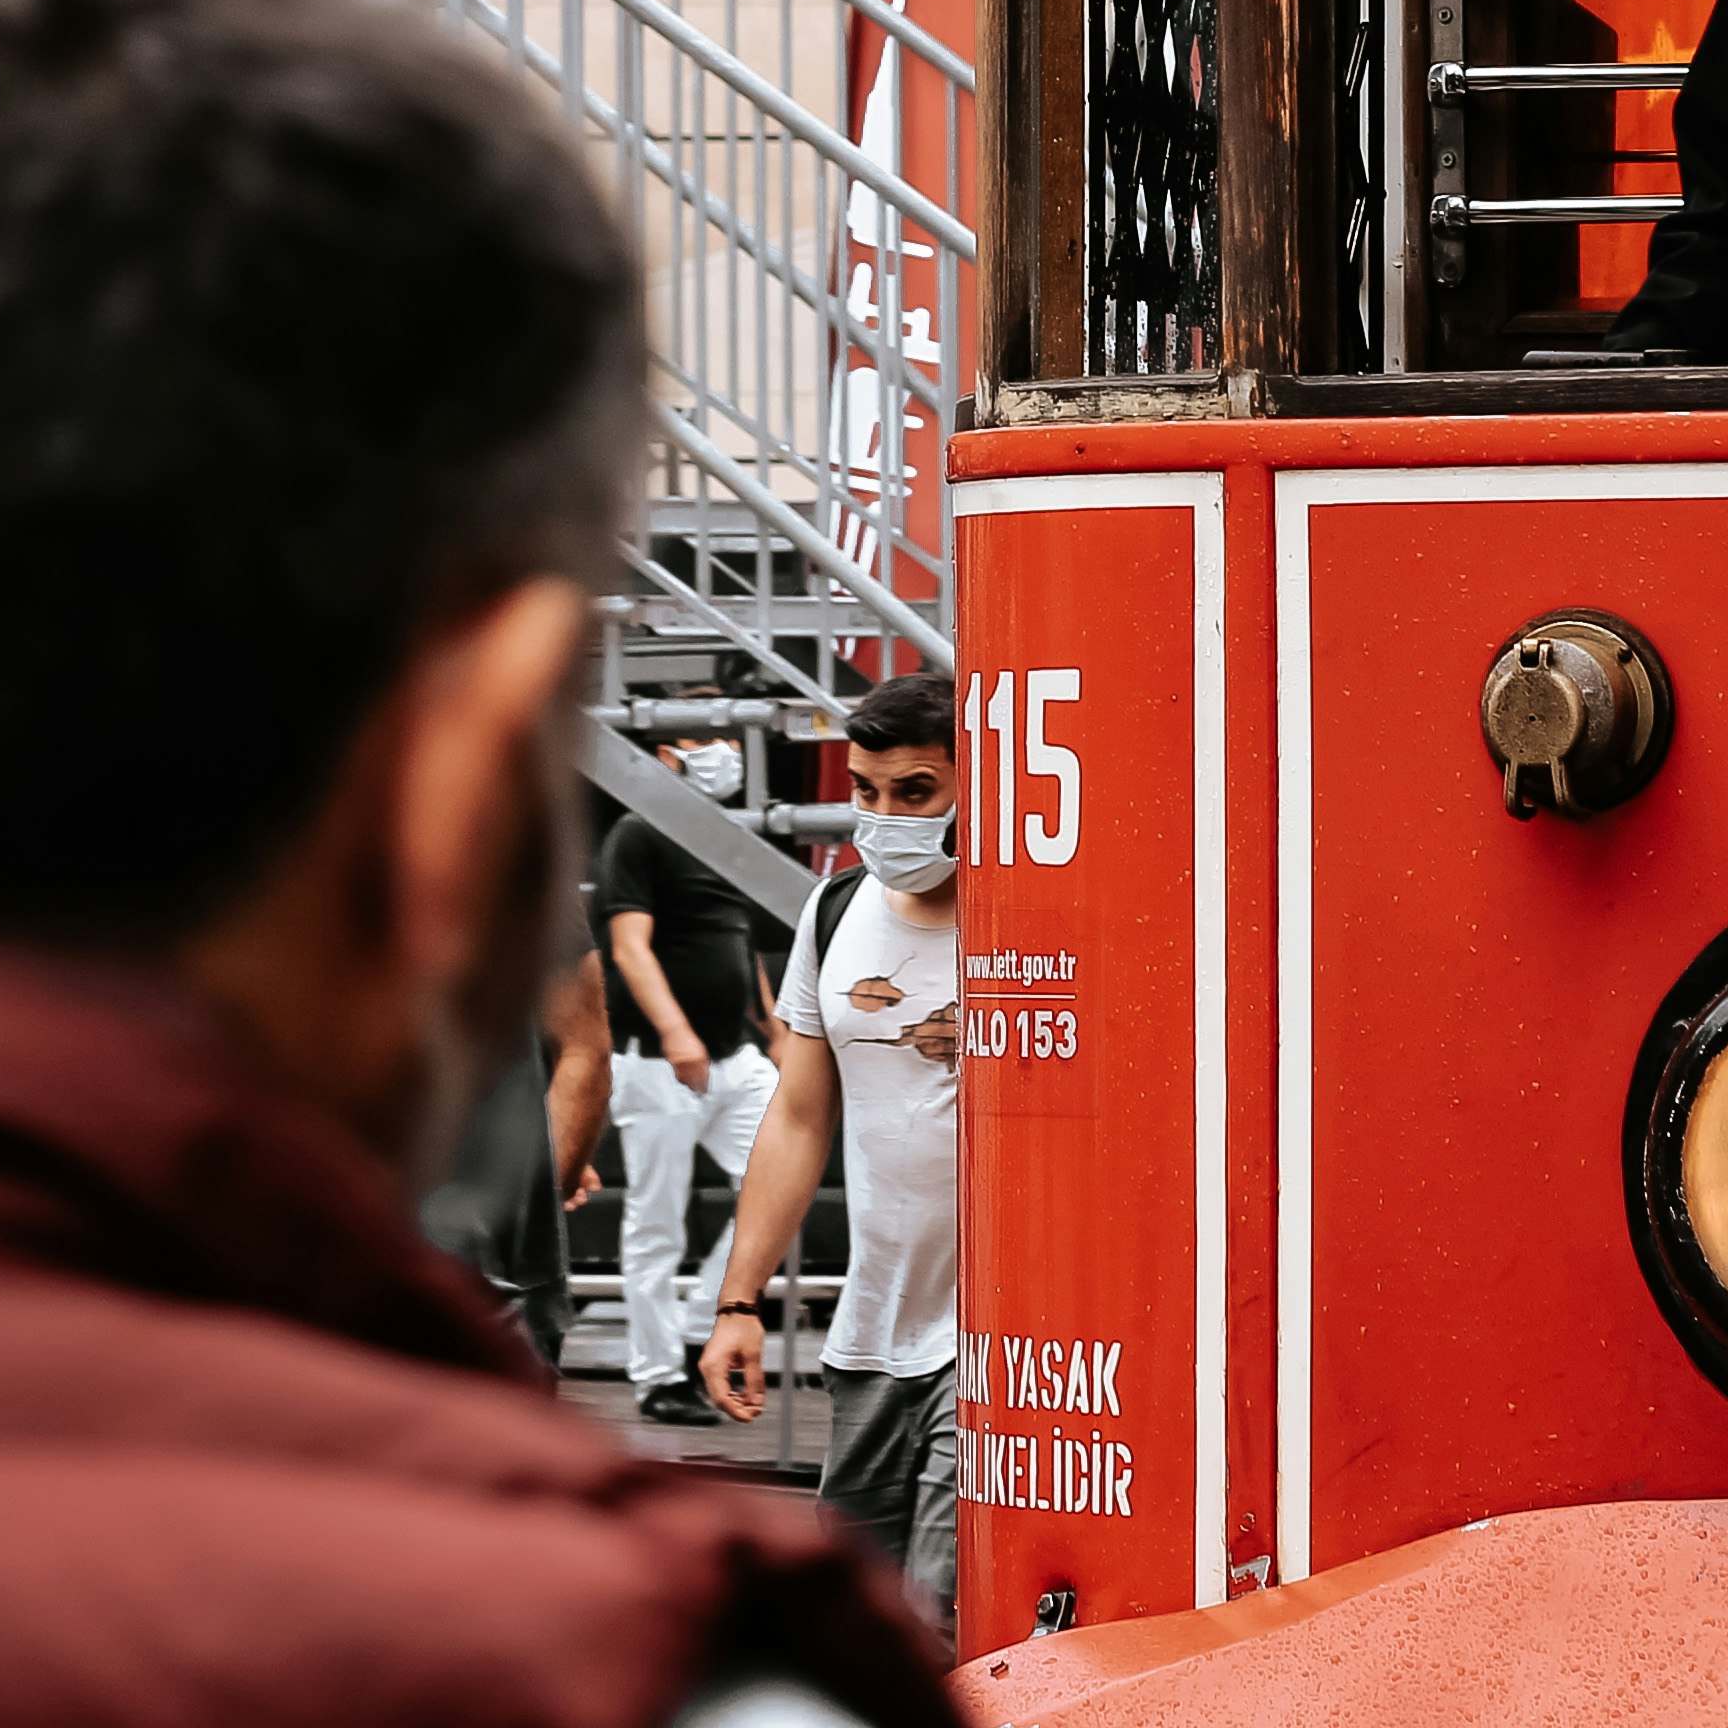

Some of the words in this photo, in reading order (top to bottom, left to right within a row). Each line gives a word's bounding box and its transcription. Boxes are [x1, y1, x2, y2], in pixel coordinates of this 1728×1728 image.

[964, 668, 1081, 866] 115
[966, 948, 1077, 987] www.iett.gov.tr
[965, 1009, 1007, 1058] ALO
[1015, 1009, 1078, 1059] 153
[1001, 1334, 1122, 1417] YASAK
